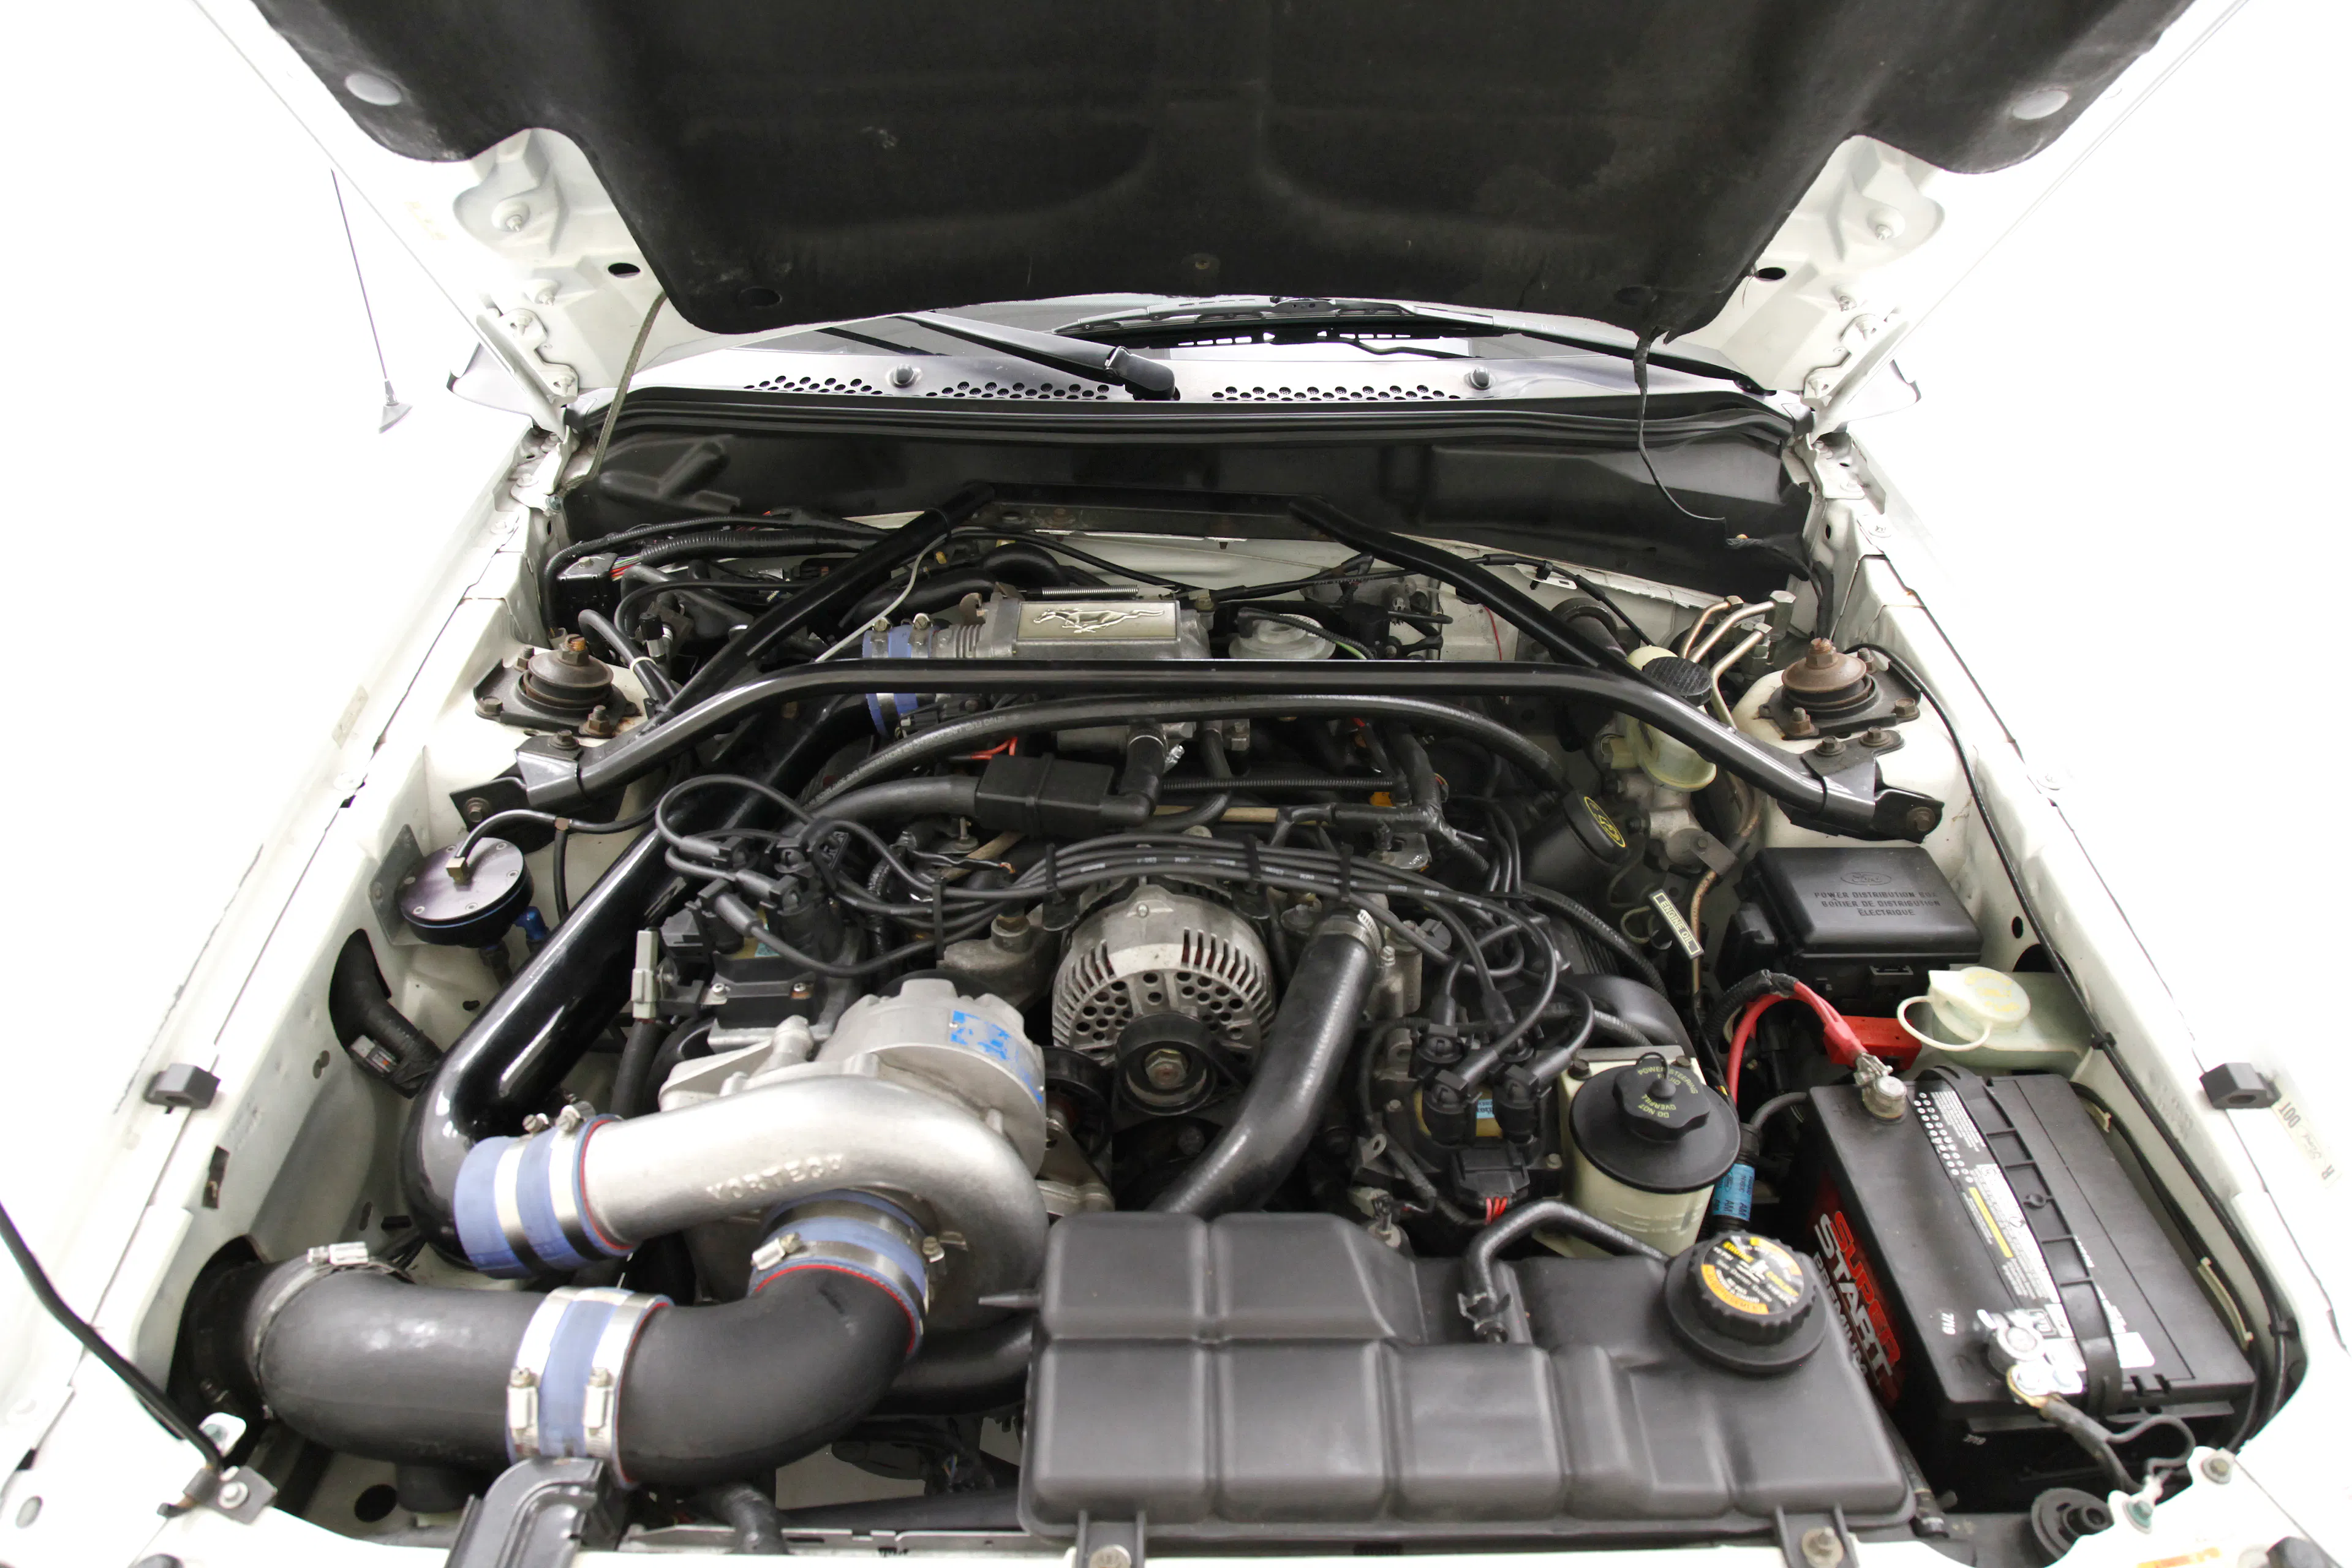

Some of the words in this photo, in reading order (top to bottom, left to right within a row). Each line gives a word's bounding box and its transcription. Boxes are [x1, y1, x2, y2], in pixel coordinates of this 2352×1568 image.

[1660, 900, 1685, 931] ENGINE
[1681, 931, 1694, 946] OIL
[1669, 1068, 1698, 1095] STEERING
[1637, 1103, 1656, 1115] NOT
[1642, 1094, 1677, 1111] OVERFILL
[1814, 1213, 1893, 1379] START
[1830, 1210, 1901, 1368] SUPER
